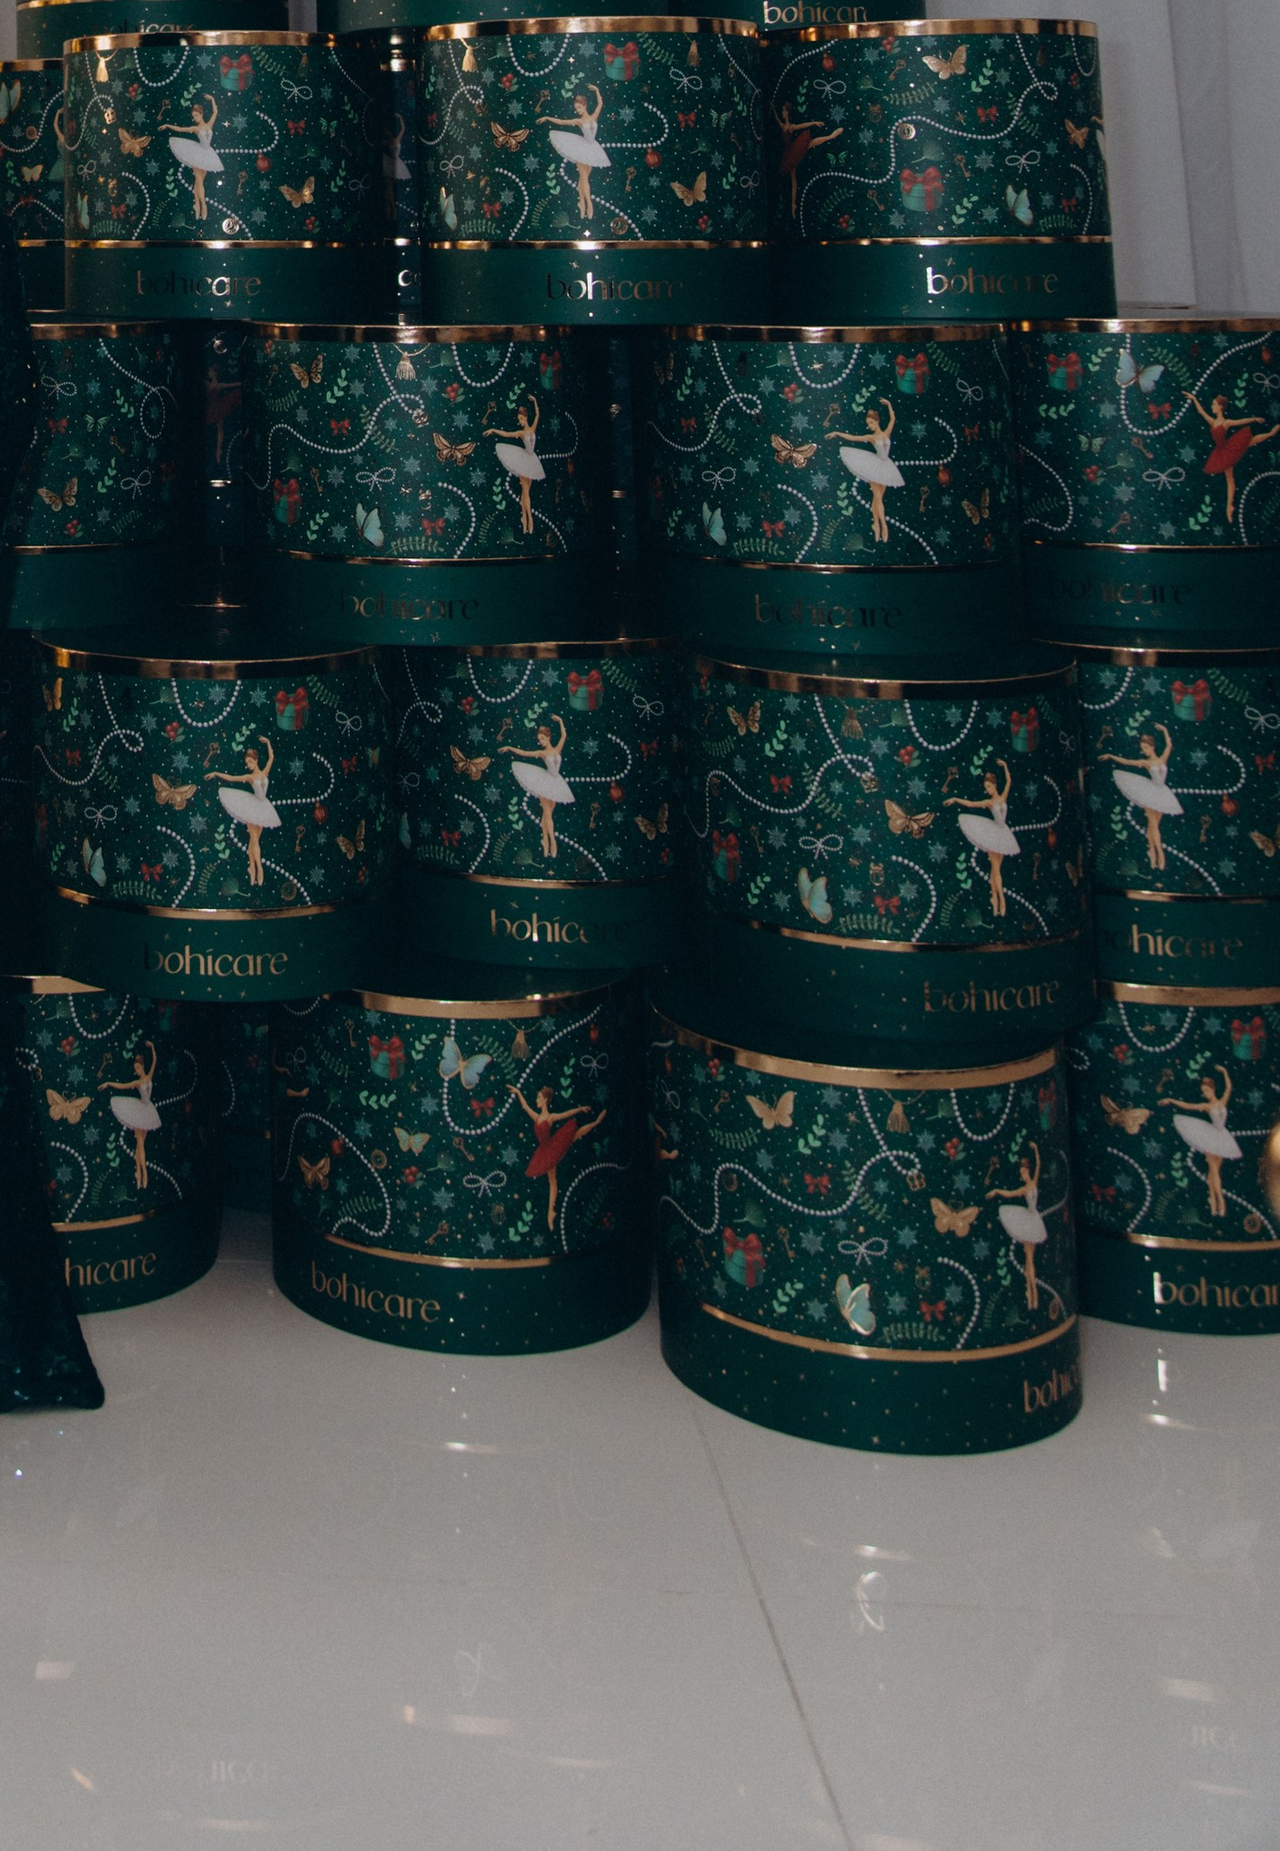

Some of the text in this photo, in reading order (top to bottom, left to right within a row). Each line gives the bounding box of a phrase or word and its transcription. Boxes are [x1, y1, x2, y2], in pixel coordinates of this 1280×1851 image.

[136, 269, 262, 297] bohicare
[546, 271, 684, 301] bohicare
[926, 266, 1059, 295] bohicare
[754, 593, 903, 629] bohicare
[144, 941, 289, 977] bohicare
[923, 980, 1060, 1013] bohicare
[64, 1252, 157, 1287] hicare
[312, 1260, 441, 1323] bohicare
